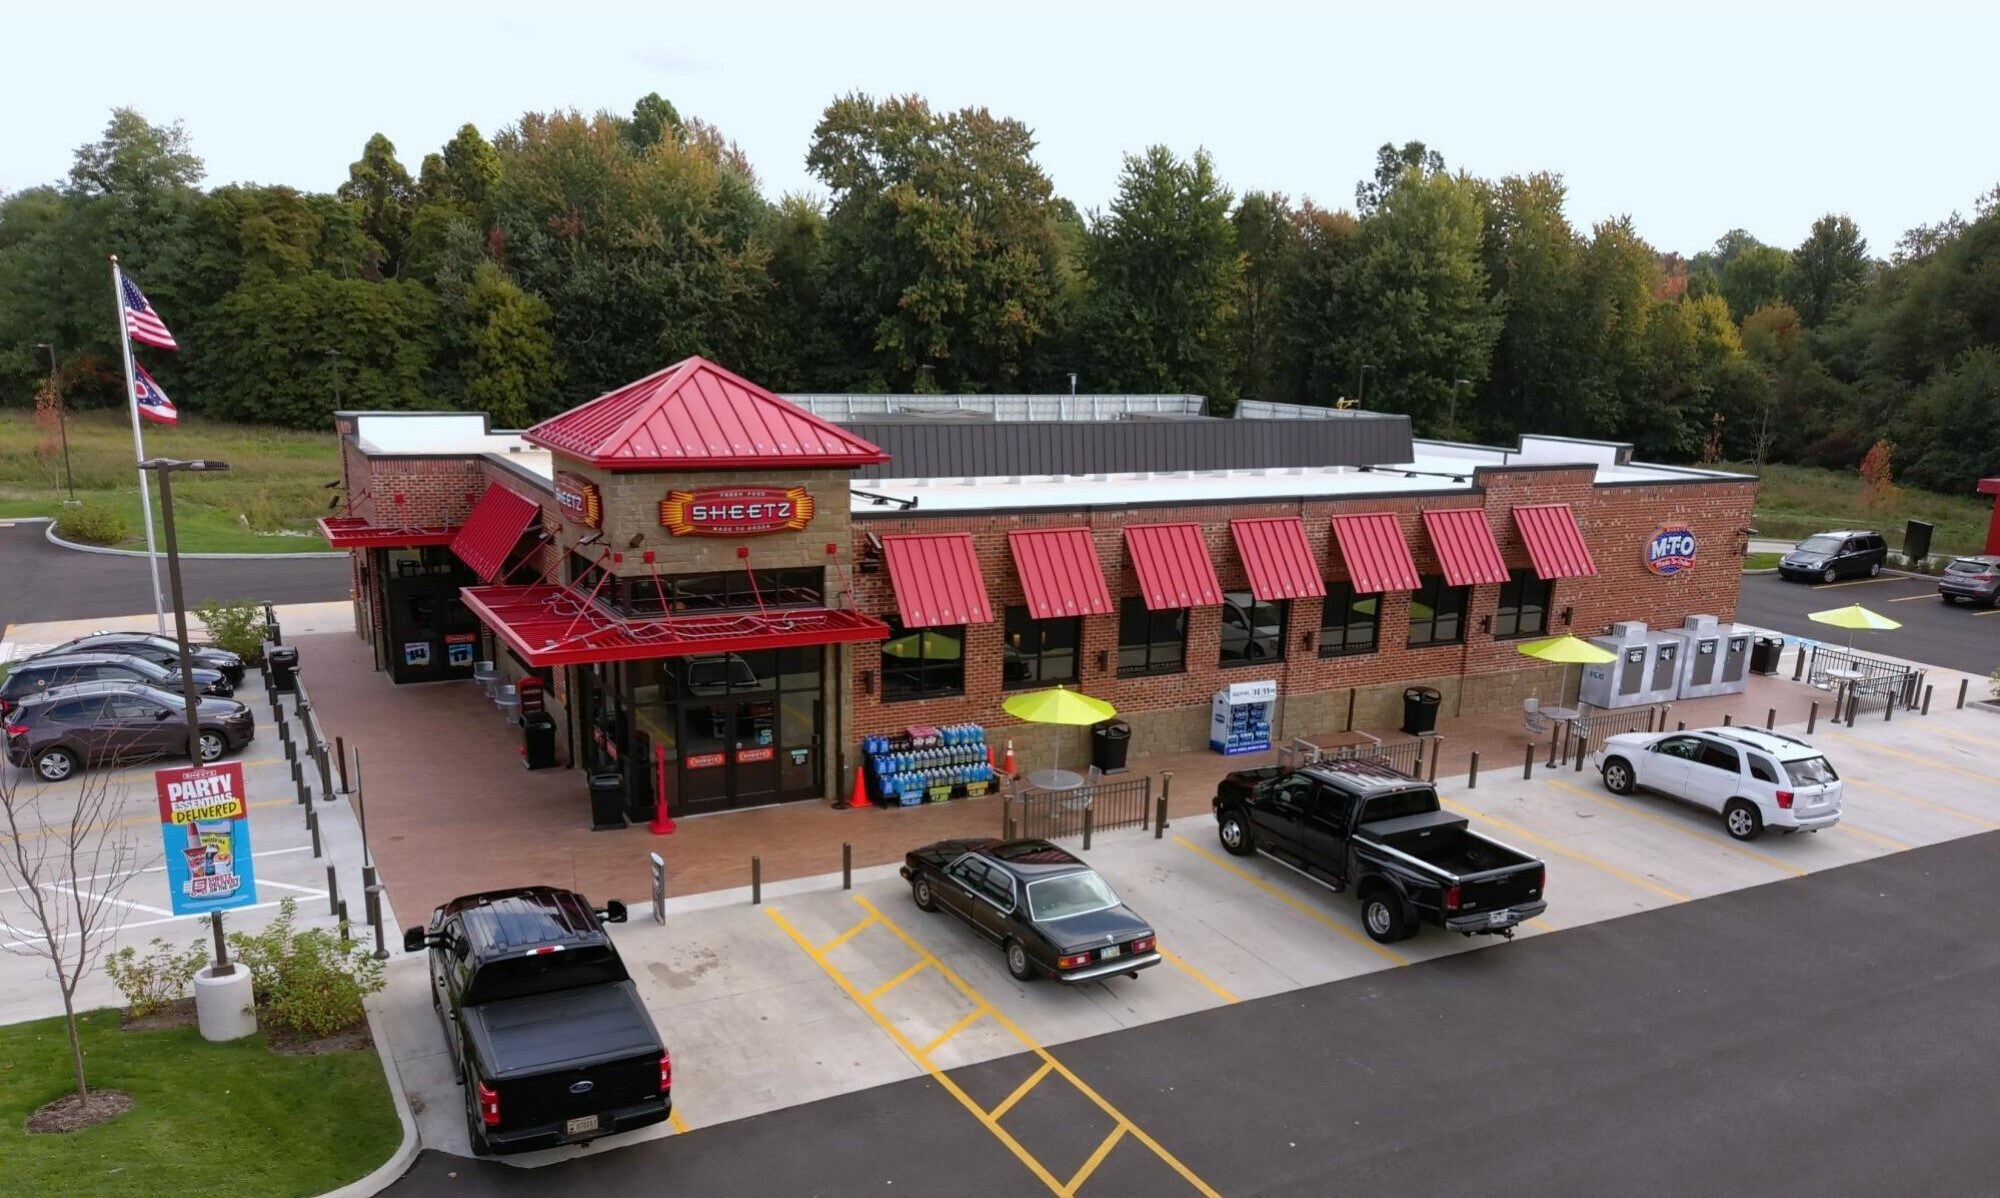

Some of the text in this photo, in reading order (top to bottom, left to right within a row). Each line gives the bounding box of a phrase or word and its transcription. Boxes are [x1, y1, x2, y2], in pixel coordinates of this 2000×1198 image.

[692, 502, 791, 521] SHEETZ
[167, 773, 232, 802] PARTY
[176, 801, 237, 823] DELIVERED
